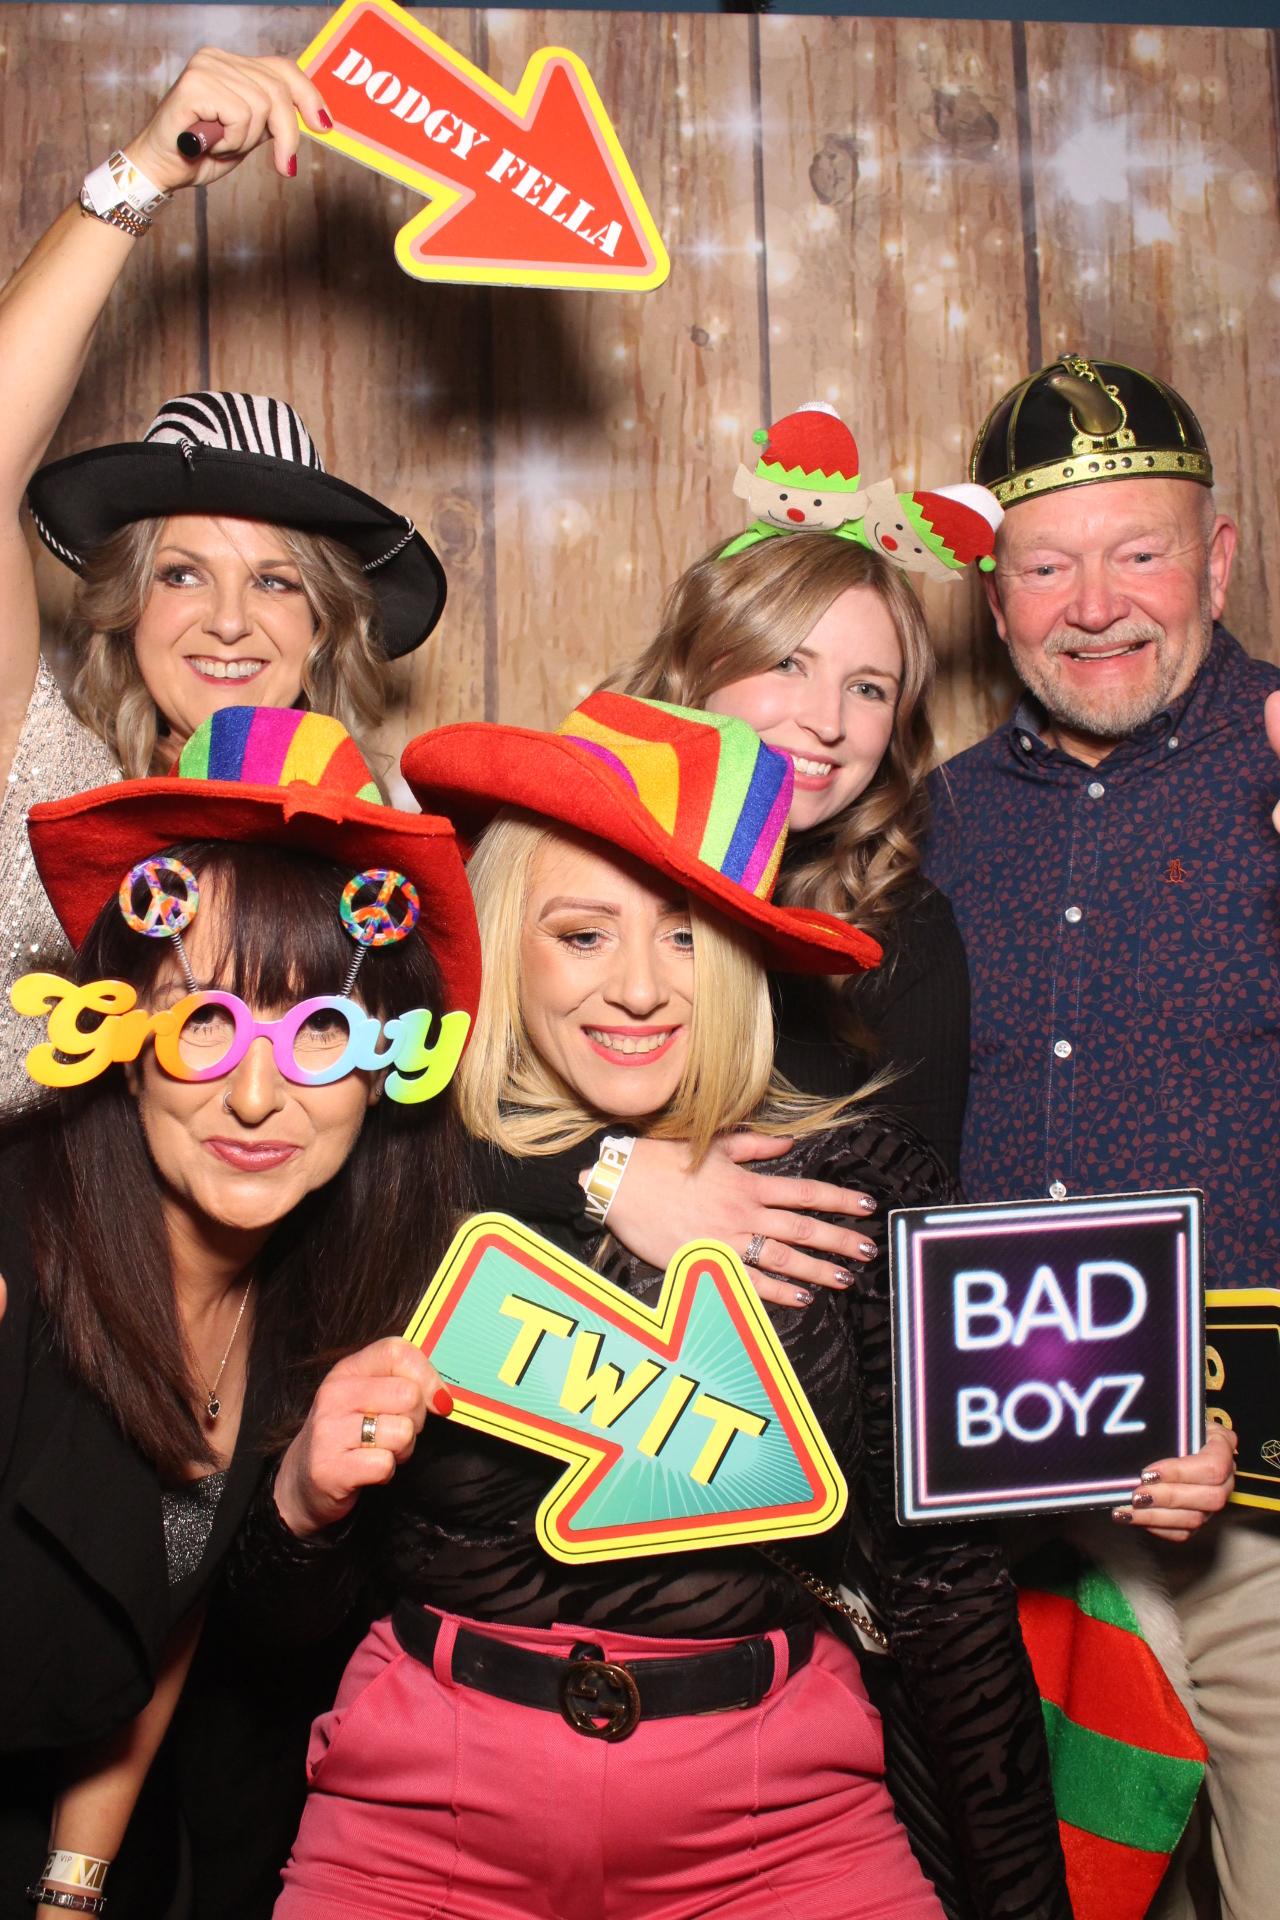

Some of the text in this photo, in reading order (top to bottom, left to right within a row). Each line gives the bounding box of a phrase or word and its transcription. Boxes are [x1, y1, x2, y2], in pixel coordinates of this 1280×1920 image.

[331, 48, 624, 258] DODGY FELLA
[10, 972, 471, 1104] Groovy
[954, 1261, 1147, 1350] BAD
[497, 1293, 771, 1487] TWIT
[957, 1374, 1146, 1447] BOYZ
